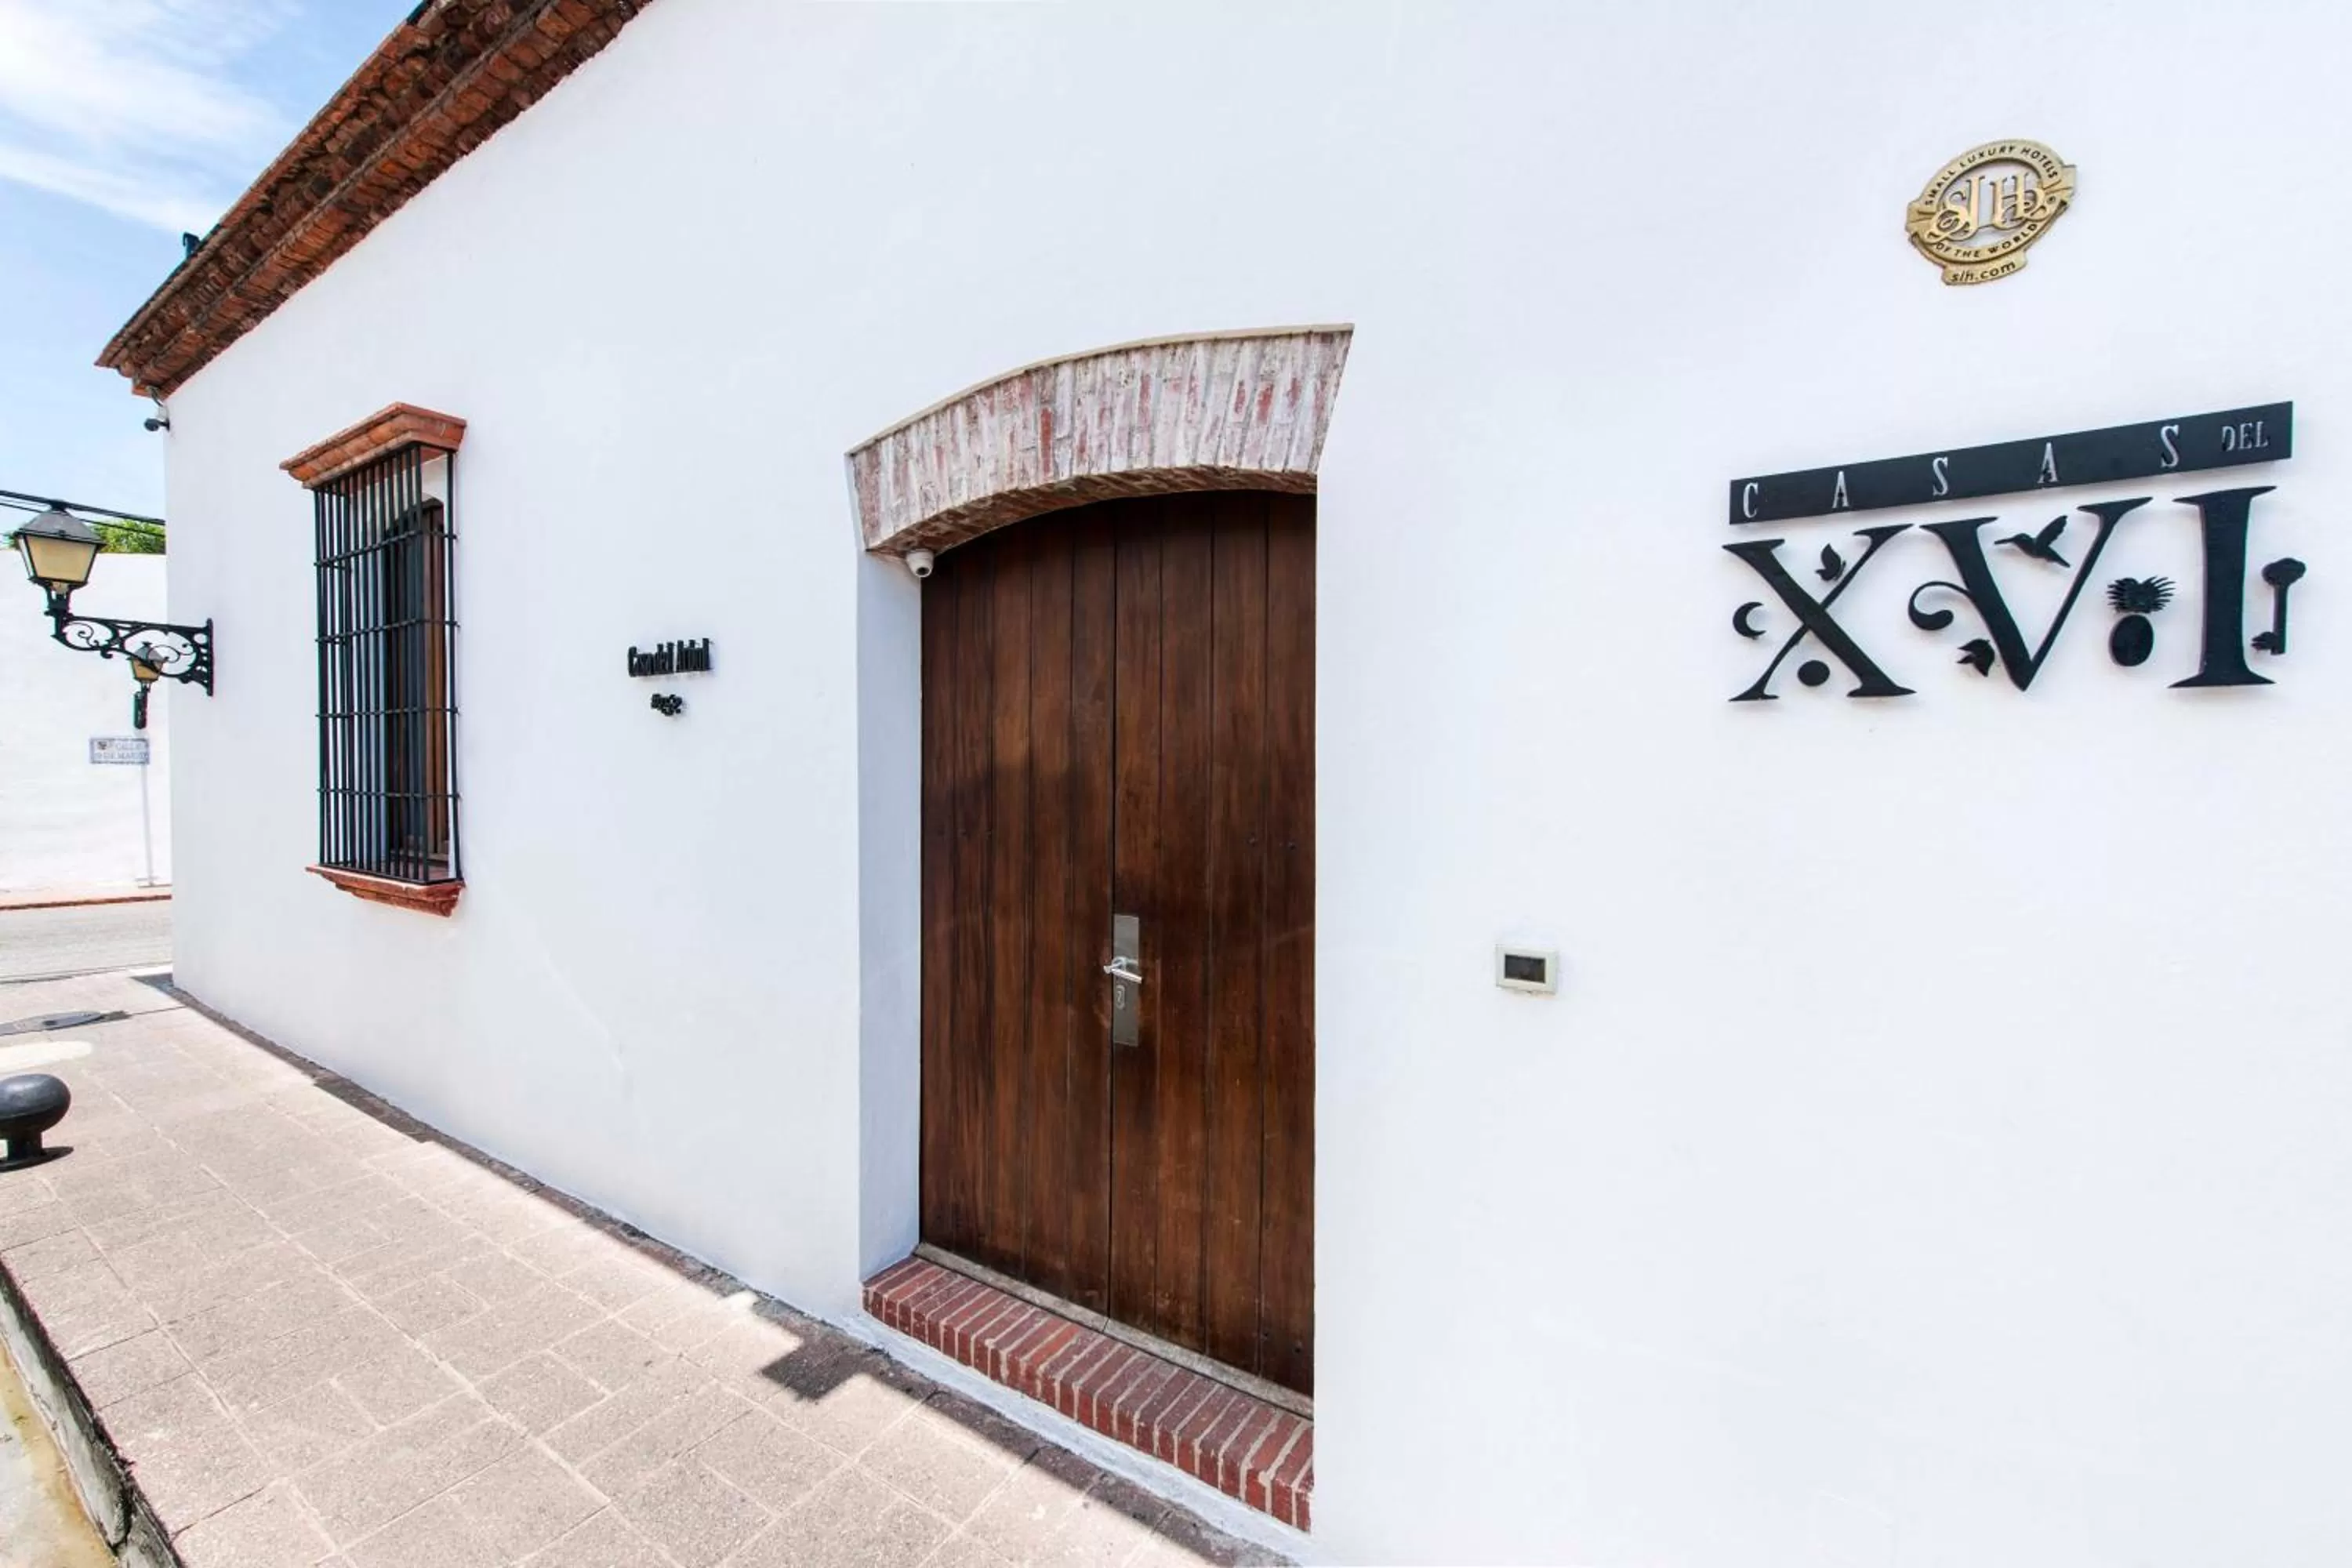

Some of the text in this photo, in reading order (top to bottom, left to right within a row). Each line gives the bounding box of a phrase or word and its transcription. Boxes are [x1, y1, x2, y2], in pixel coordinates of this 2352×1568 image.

[1925, 145, 2058, 205] SMALL LUXURY HOTELS
[1954, 249, 1980, 258] THE
[1987, 223, 2038, 254] WORLD
[1951, 261, 2016, 281] slh.com
[1742, 420, 2270, 519] CASAS DEL
[1722, 485, 2277, 702] XVI
